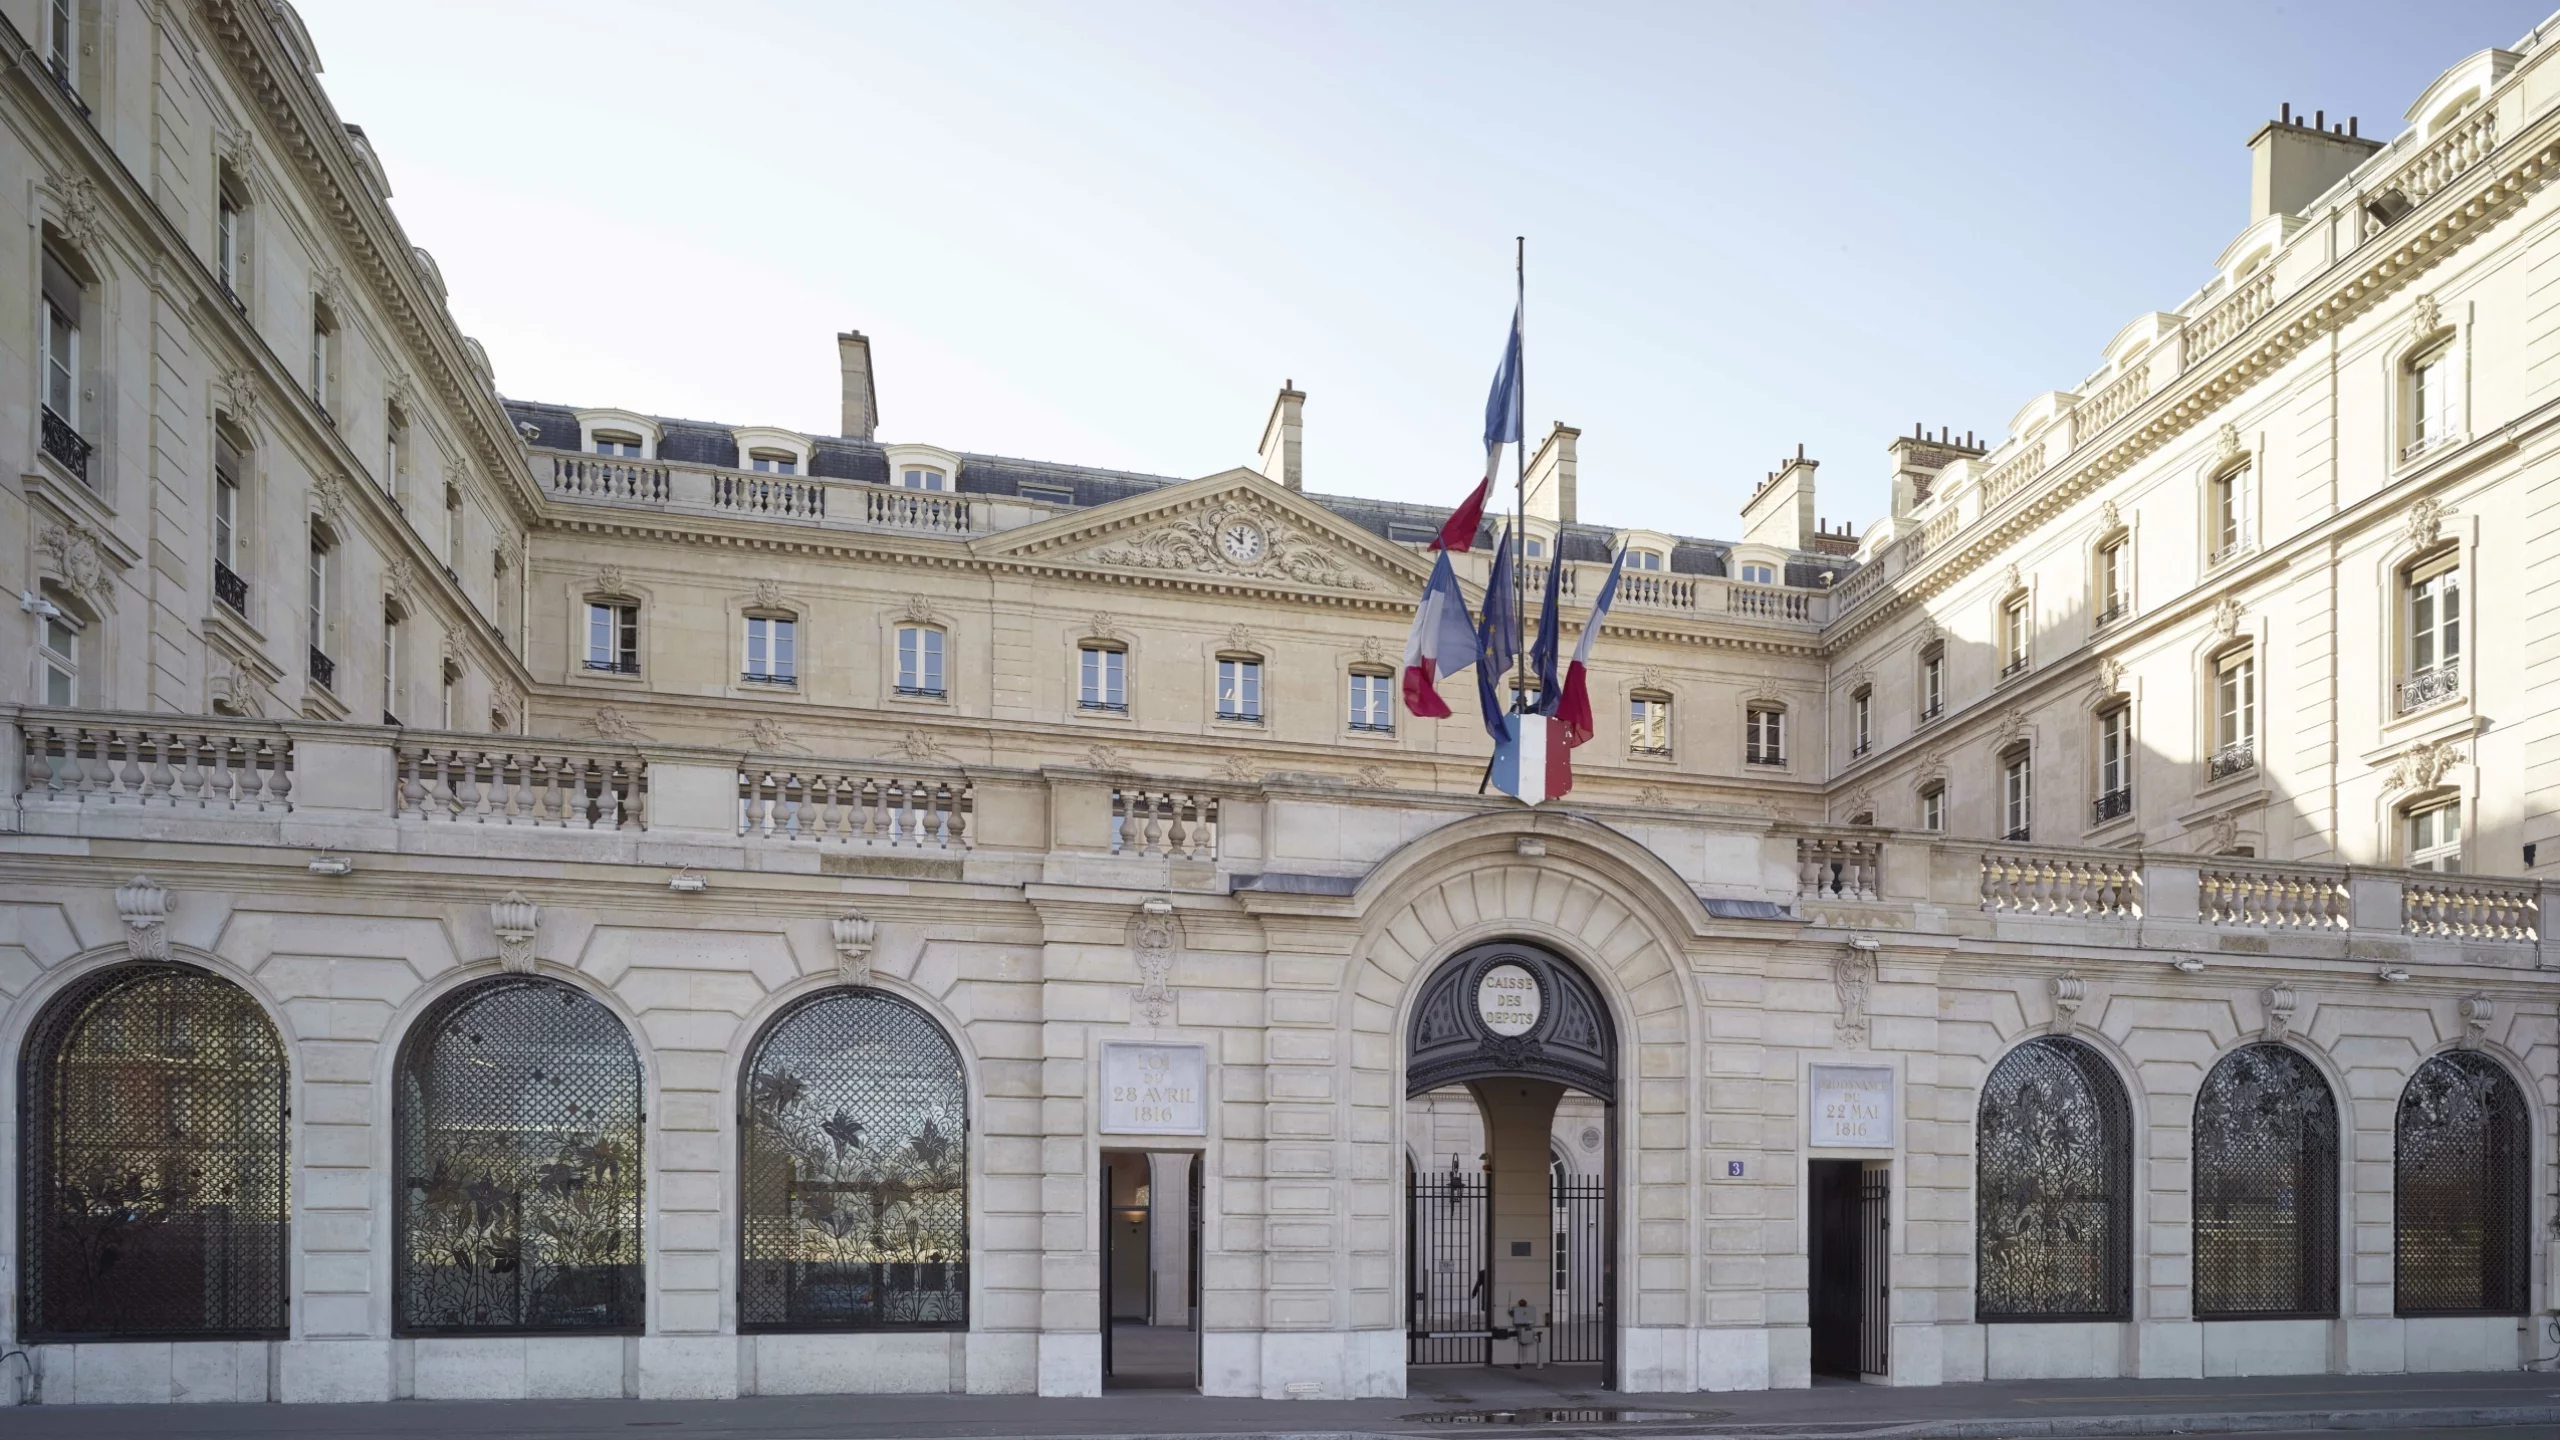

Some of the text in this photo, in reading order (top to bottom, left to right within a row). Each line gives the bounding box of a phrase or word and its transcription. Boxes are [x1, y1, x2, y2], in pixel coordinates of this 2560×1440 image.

[1486, 977, 1533, 990] CAISSE
[1497, 995, 1522, 1007] DES
[1138, 1054, 1170, 1071] LOI
[1143, 1073, 1164, 1084] DU
[1113, 1086, 1195, 1104] 28 AVRIL
[1844, 1092, 1861, 1103] DU
[1134, 1106, 1173, 1122] 1816
[1826, 1104, 1878, 1119] 22 MAI
[1836, 1122, 1867, 1136] 1816
[1732, 1162, 1741, 1176] 3
